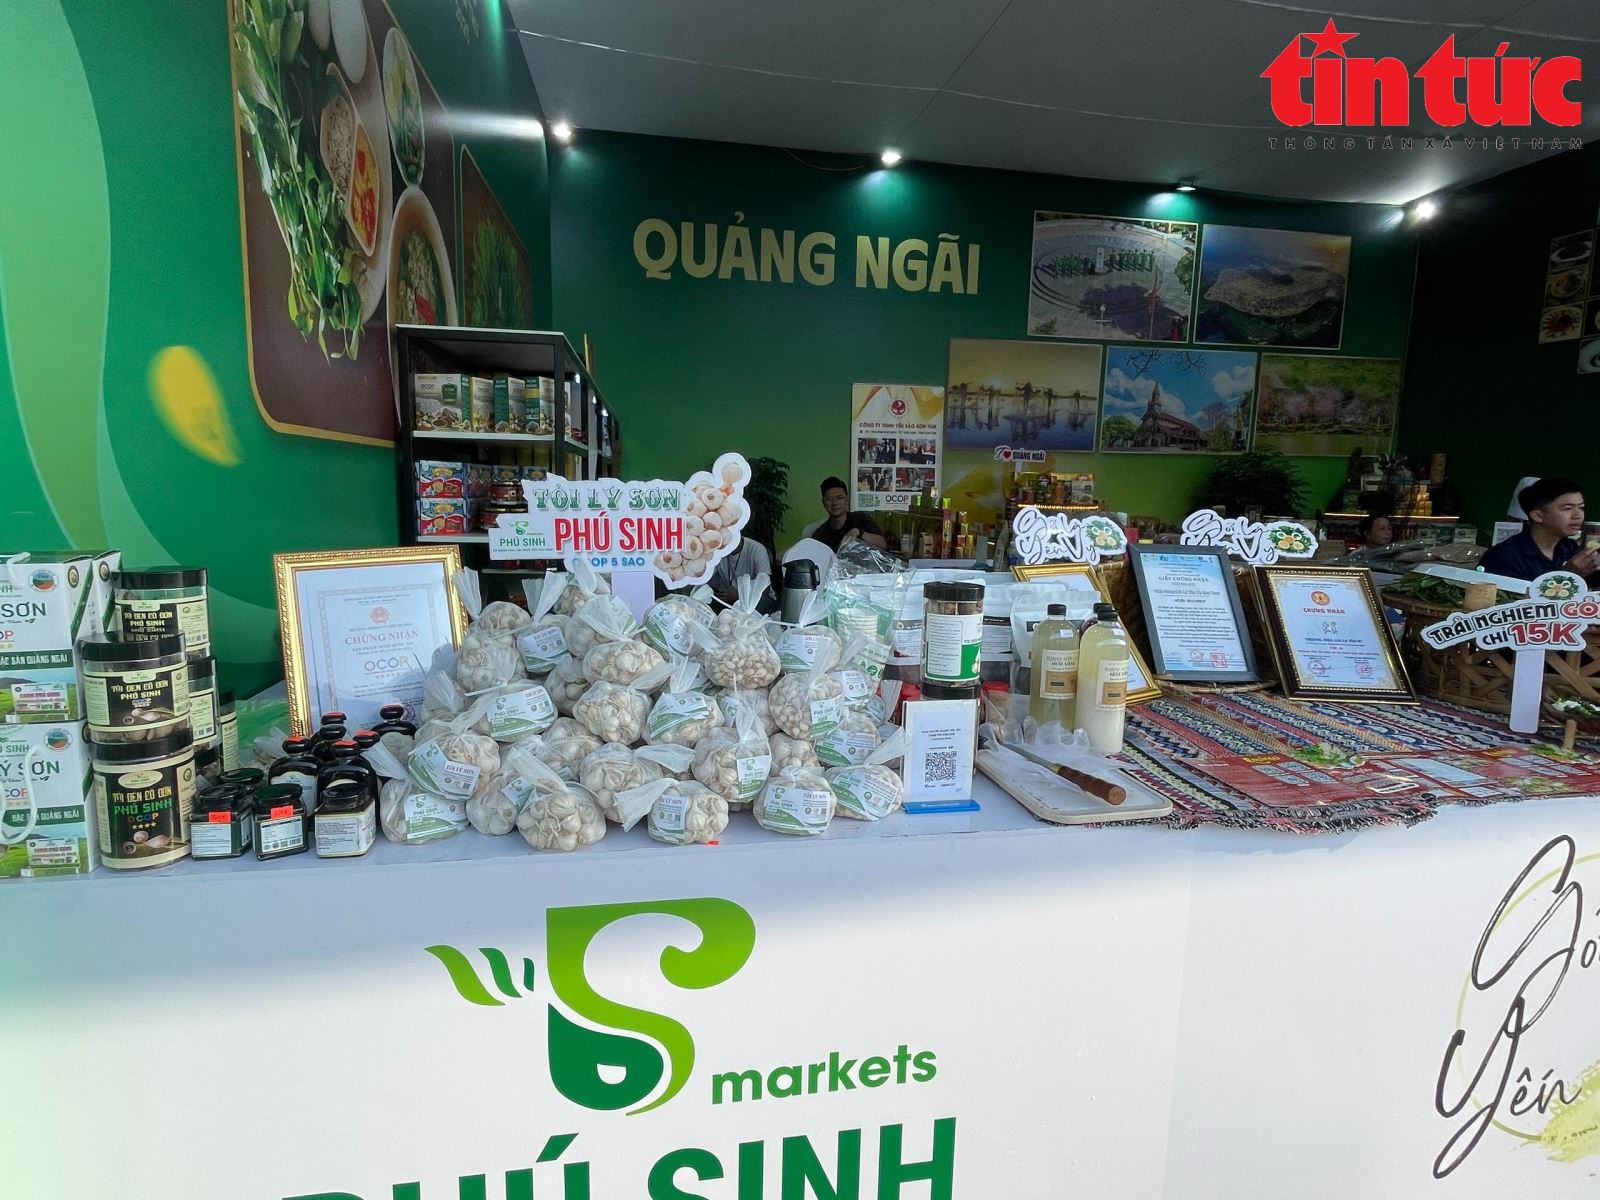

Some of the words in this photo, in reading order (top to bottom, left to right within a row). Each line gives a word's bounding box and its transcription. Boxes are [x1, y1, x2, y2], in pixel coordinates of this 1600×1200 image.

[633, 211, 836, 286] QUẢNG
[855, 232, 981, 295] NGÃI
[532, 484, 580, 510] TỎI
[587, 485, 621, 510] LÝ
[629, 486, 680, 510] SƠN
[886, 495, 909, 503] OCOP
[554, 511, 612, 552] PHÚ
[618, 517, 684, 552] SINH
[499, 536, 520, 547] PHÚ
[522, 537, 546, 547] SINH
[571, 557, 608, 568] OOP
[610, 557, 618, 567] 5
[621, 556, 645, 567] SAO
[1, 601, 47, 618] SƠN
[1428, 616, 1474, 643] TRẢI
[1560, 596, 1600, 619] GỎ
[344, 632, 386, 645] CHỨNG
[387, 630, 418, 641] NHẬN
[1509, 622, 1580, 646] 15K
[27, 653, 50, 665] QUẢNG
[364, 656, 408, 672] OCOP
[141, 690, 161, 698] SINH
[114, 802, 139, 815] PHÚ
[142, 798, 172, 813] SINH
[711, 1044, 937, 1105] markets
[1432, 994, 1583, 1180] Yến
